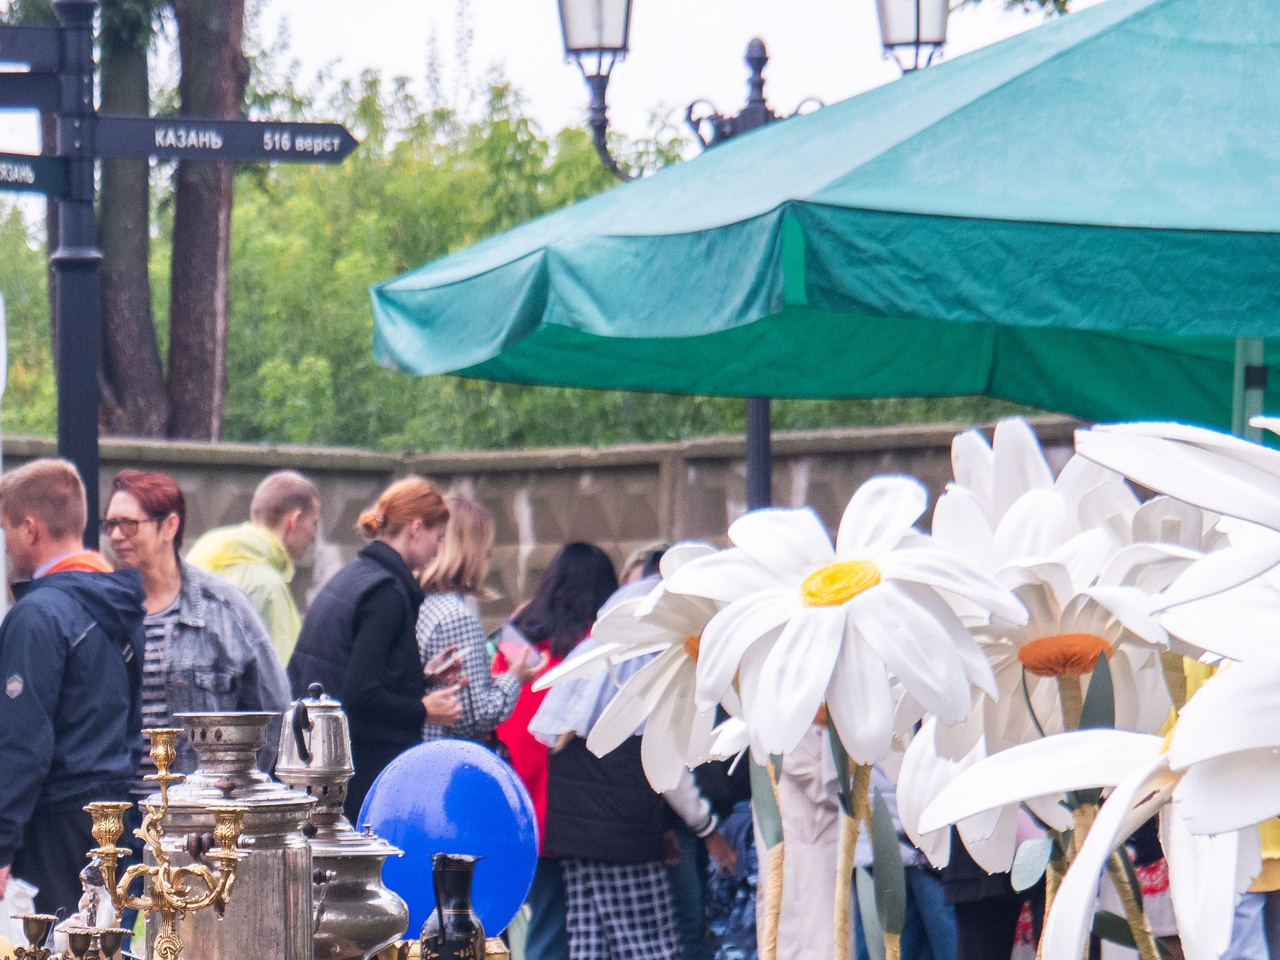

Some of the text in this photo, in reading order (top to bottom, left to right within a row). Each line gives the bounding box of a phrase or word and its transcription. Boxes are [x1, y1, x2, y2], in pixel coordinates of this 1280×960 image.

[154, 127, 341, 155] КАЗАНЬ 516 верст
